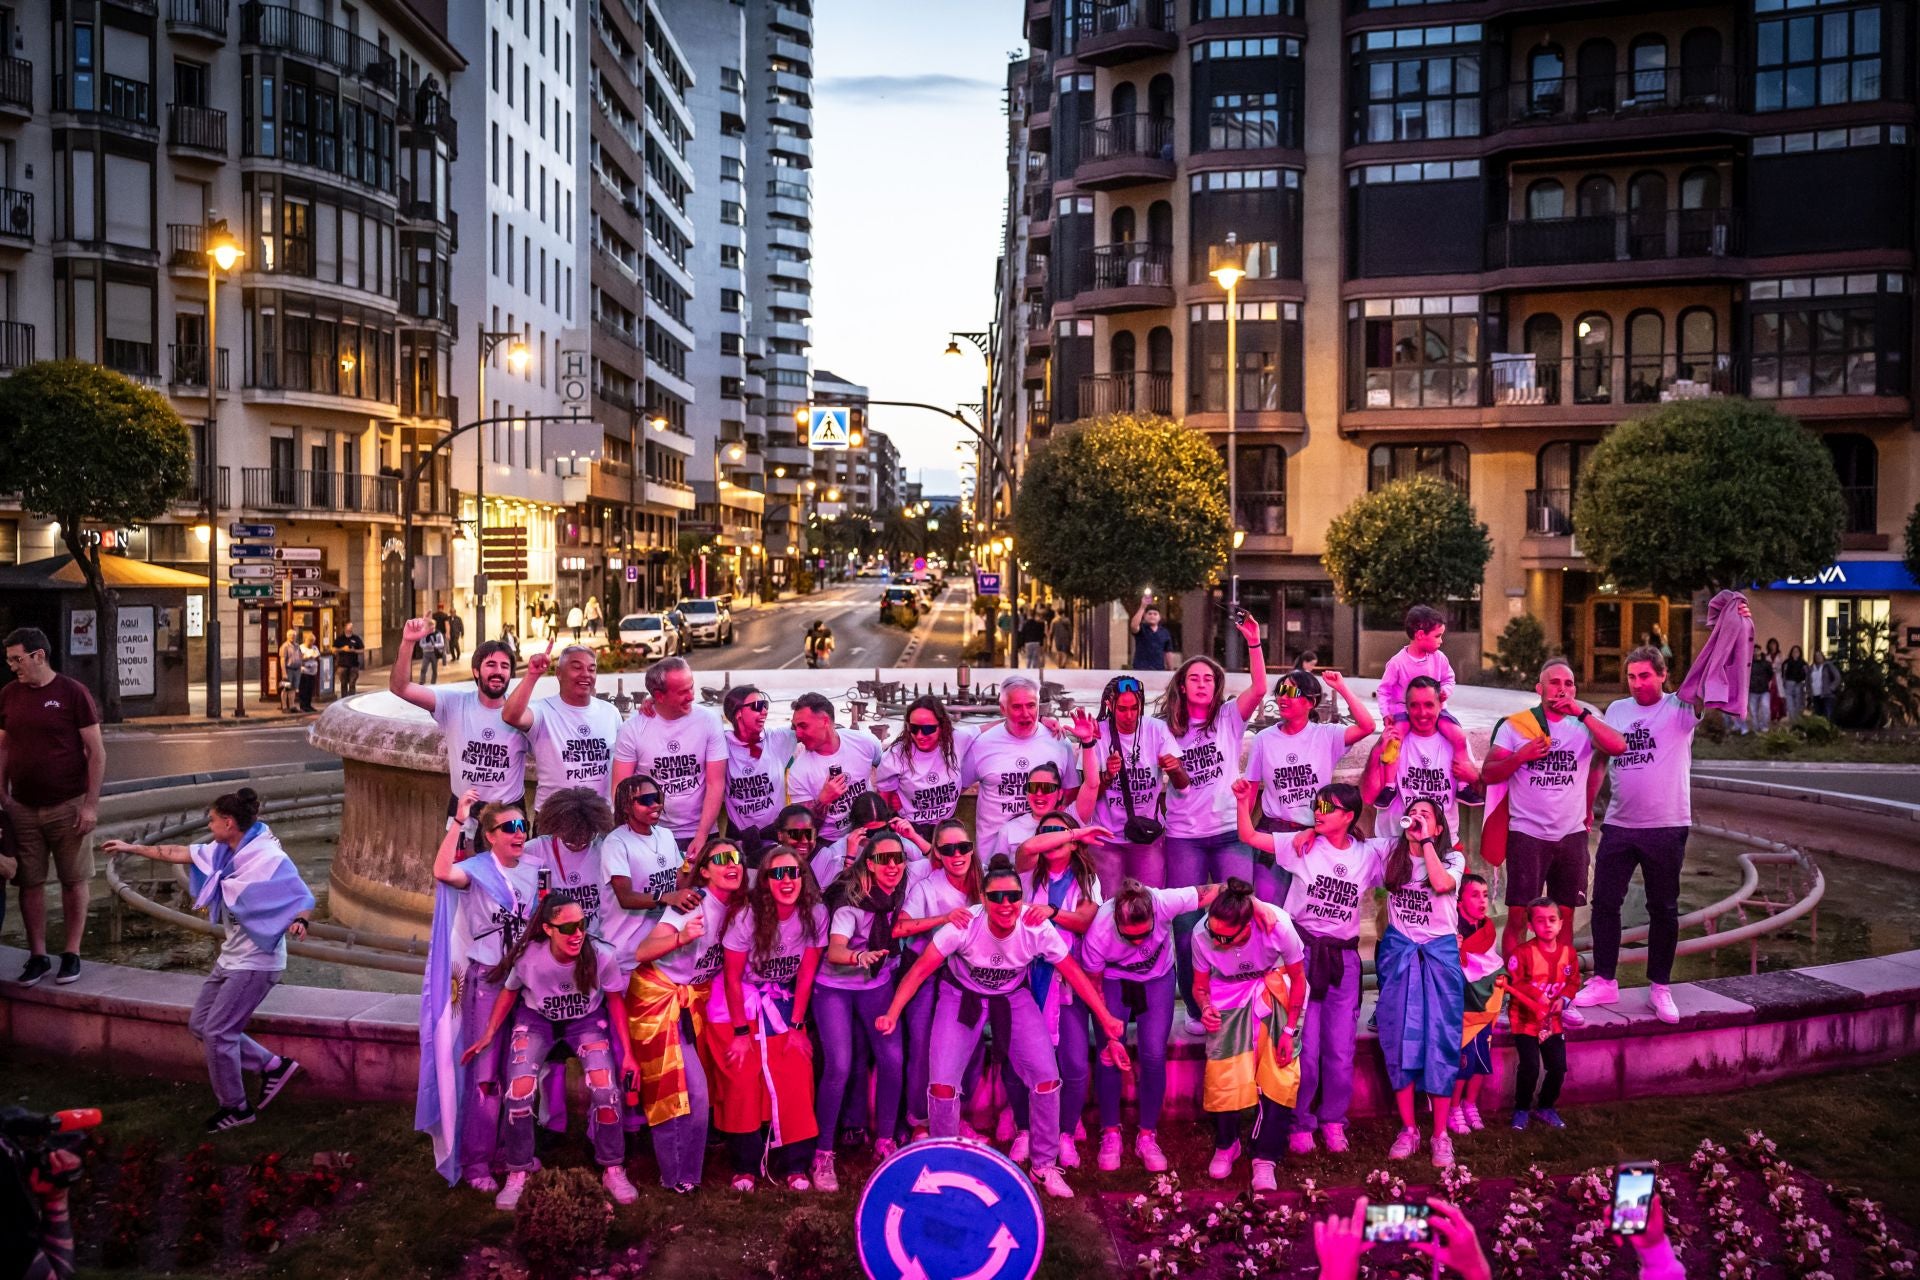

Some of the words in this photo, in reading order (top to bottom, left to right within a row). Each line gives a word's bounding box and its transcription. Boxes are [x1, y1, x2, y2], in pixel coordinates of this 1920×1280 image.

[565, 356, 585, 475] HOTL
[121, 618, 139, 628] AQUÍ
[118, 635, 149, 644] ECARGA
[126, 646, 135, 654] TU
[117, 656, 148, 665] ONOBUS
[467, 741, 508, 757] SOMOS
[566, 738, 608, 751] SOMOS
[1629, 738, 1656, 751] ORIA
[654, 754, 697, 769] SOMOS
[461, 770, 505, 783] PRIMERA
[566, 764, 609, 780] PRIMERA
[1001, 772, 1029, 785] SOM
[1190, 766, 1223, 787] RIMERA
[1274, 764, 1313, 779] SOMOS
[1407, 766, 1444, 781] SOMOS
[730, 773, 770, 789] SOMOS
[1529, 774, 1574, 787] PRIMERA
[914, 781, 956, 800] SOMOS
[998, 784, 1027, 796] HIST
[1001, 801, 1032, 813] PRIME
[1109, 792, 1154, 807] PRERA
[1315, 874, 1359, 896] SOMOS
[1306, 904, 1352, 922] PRIMERA
[543, 993, 590, 1009] SOMOS
